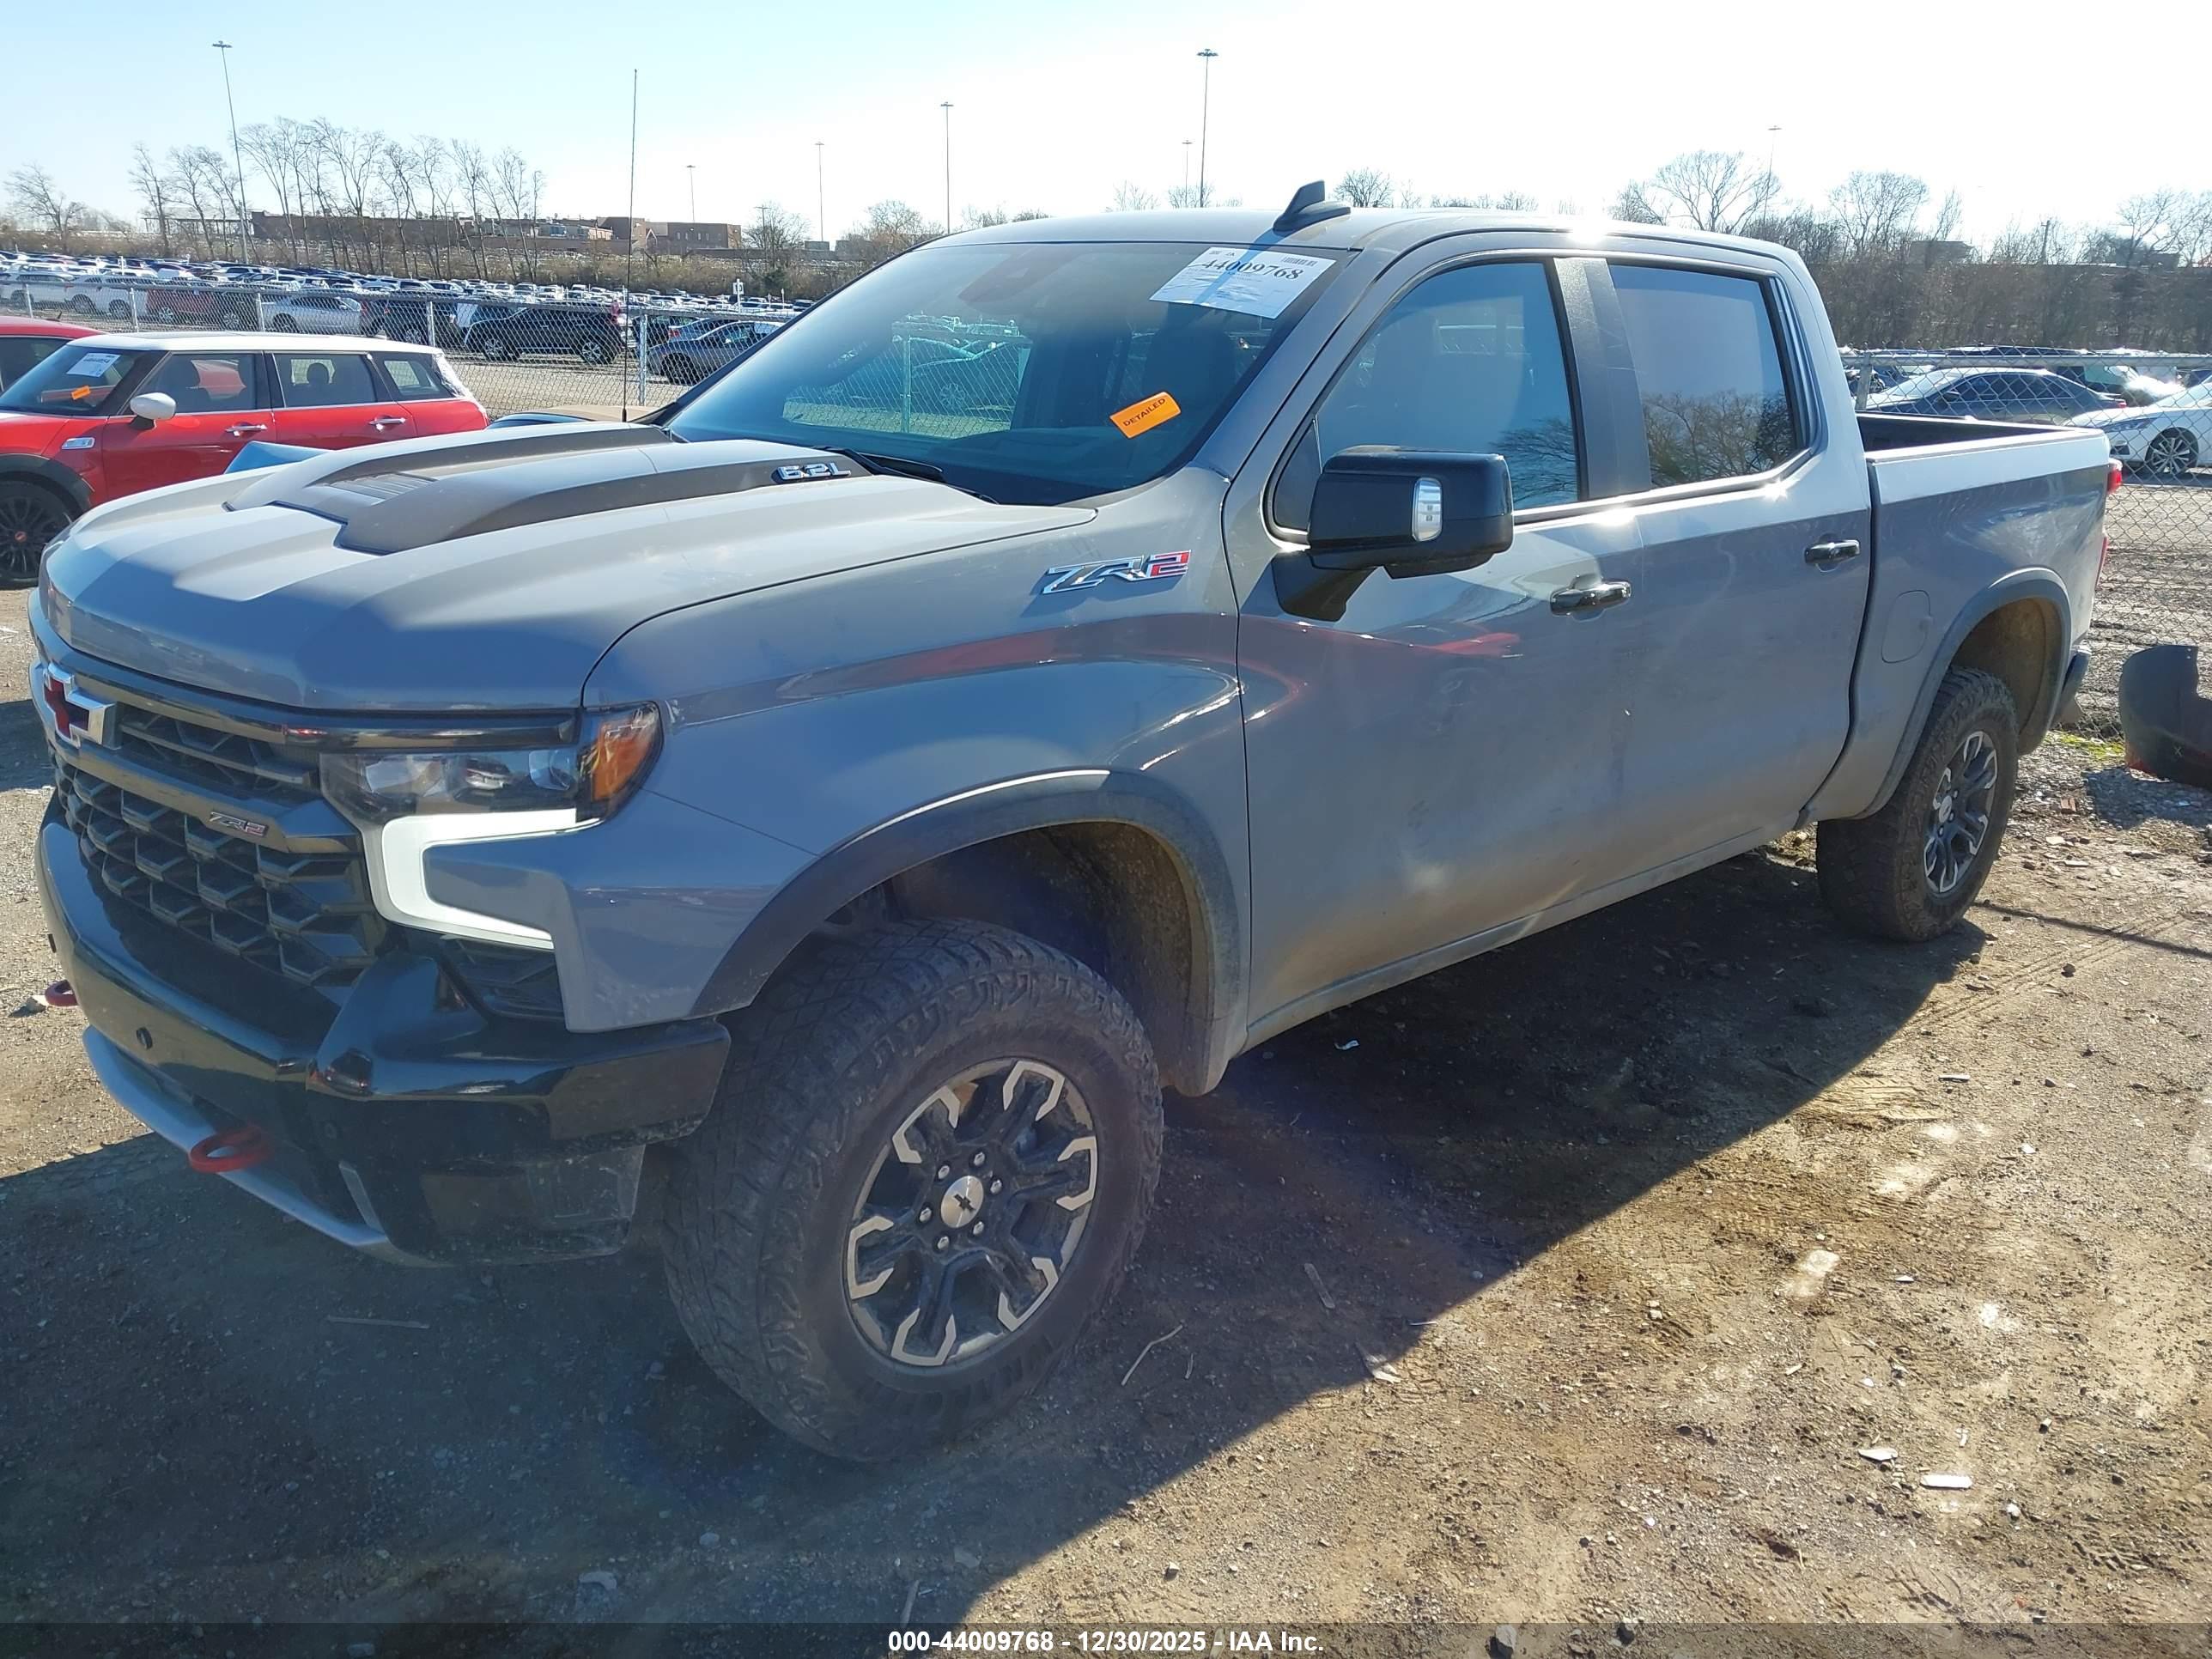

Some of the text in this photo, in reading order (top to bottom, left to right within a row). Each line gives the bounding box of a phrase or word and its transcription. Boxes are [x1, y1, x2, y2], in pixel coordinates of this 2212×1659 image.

[1202, 258, 1304, 280] 44009768
[1123, 398, 1166, 426] DETAILED
[1042, 550, 1192, 594] ZR2
